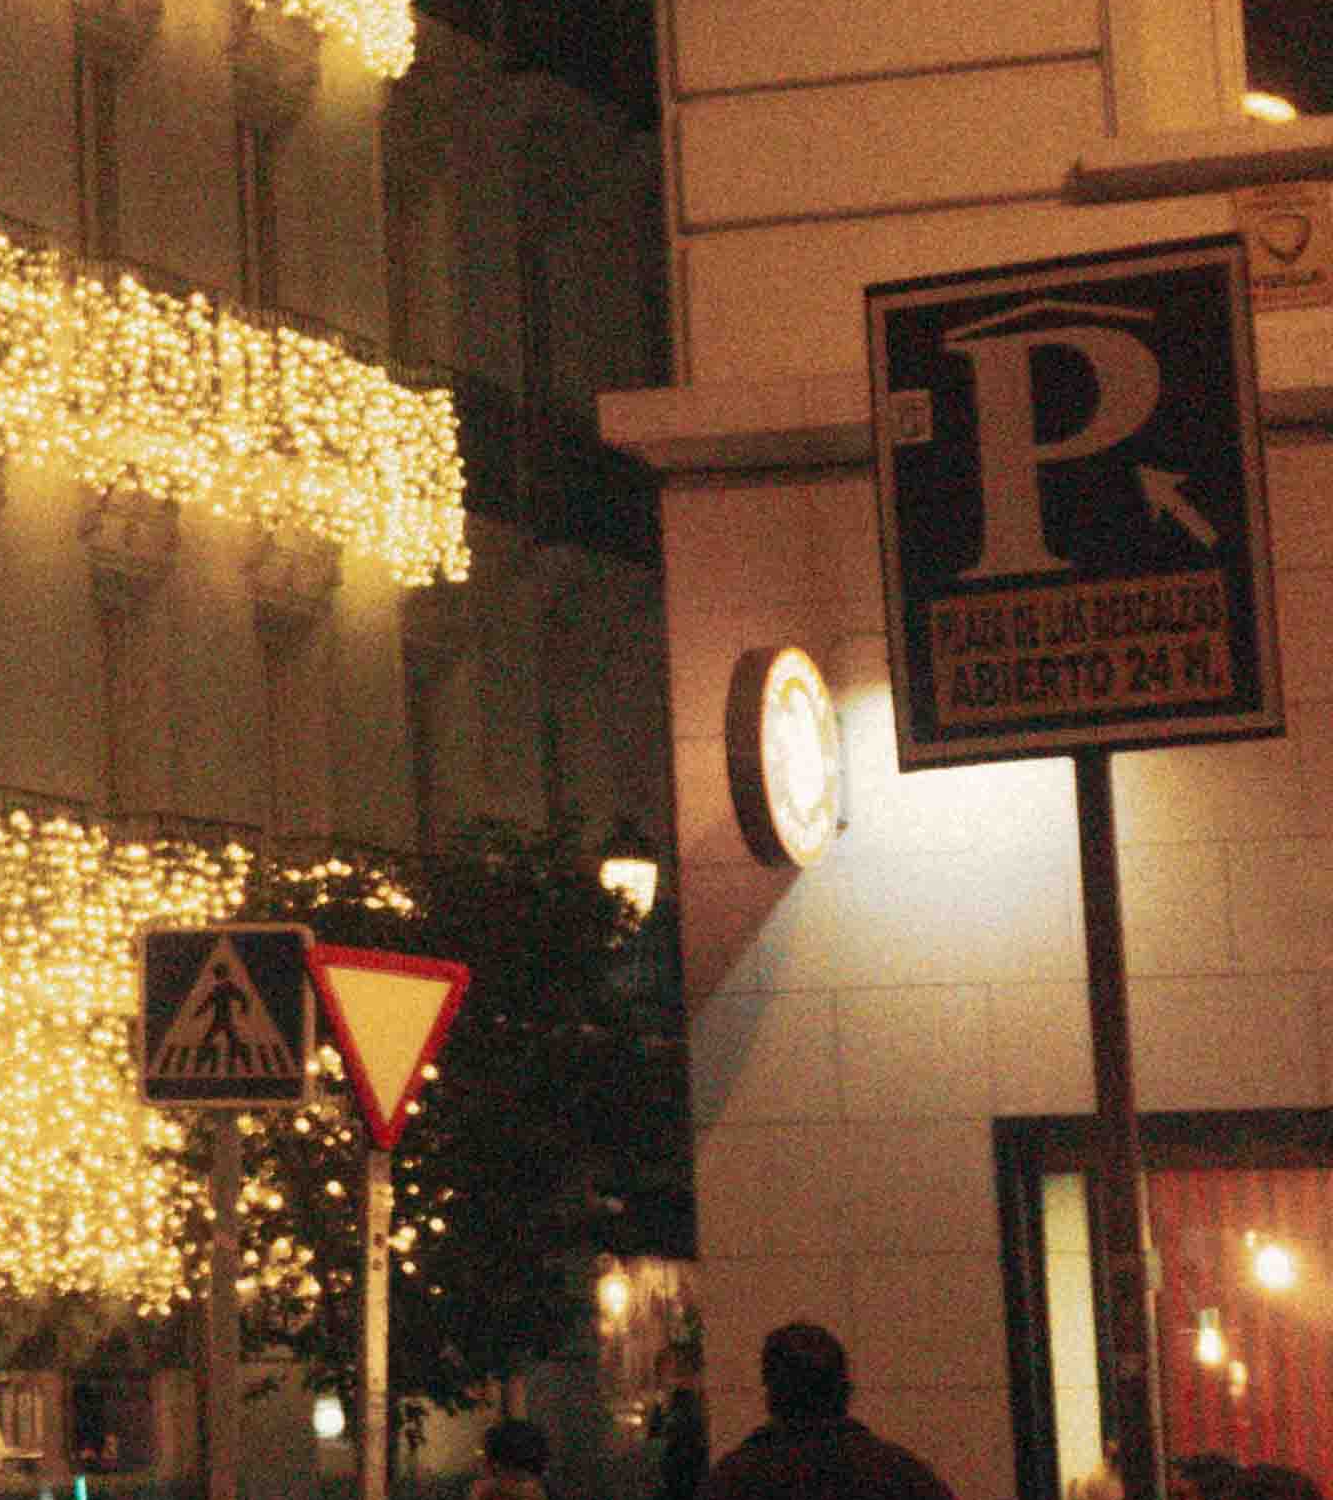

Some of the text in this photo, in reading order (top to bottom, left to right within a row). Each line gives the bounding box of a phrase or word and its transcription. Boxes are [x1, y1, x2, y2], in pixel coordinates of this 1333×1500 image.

[945, 326, 1161, 579] P
[952, 650, 1114, 707] ABIERTO
[1126, 644, 1173, 693] 24
